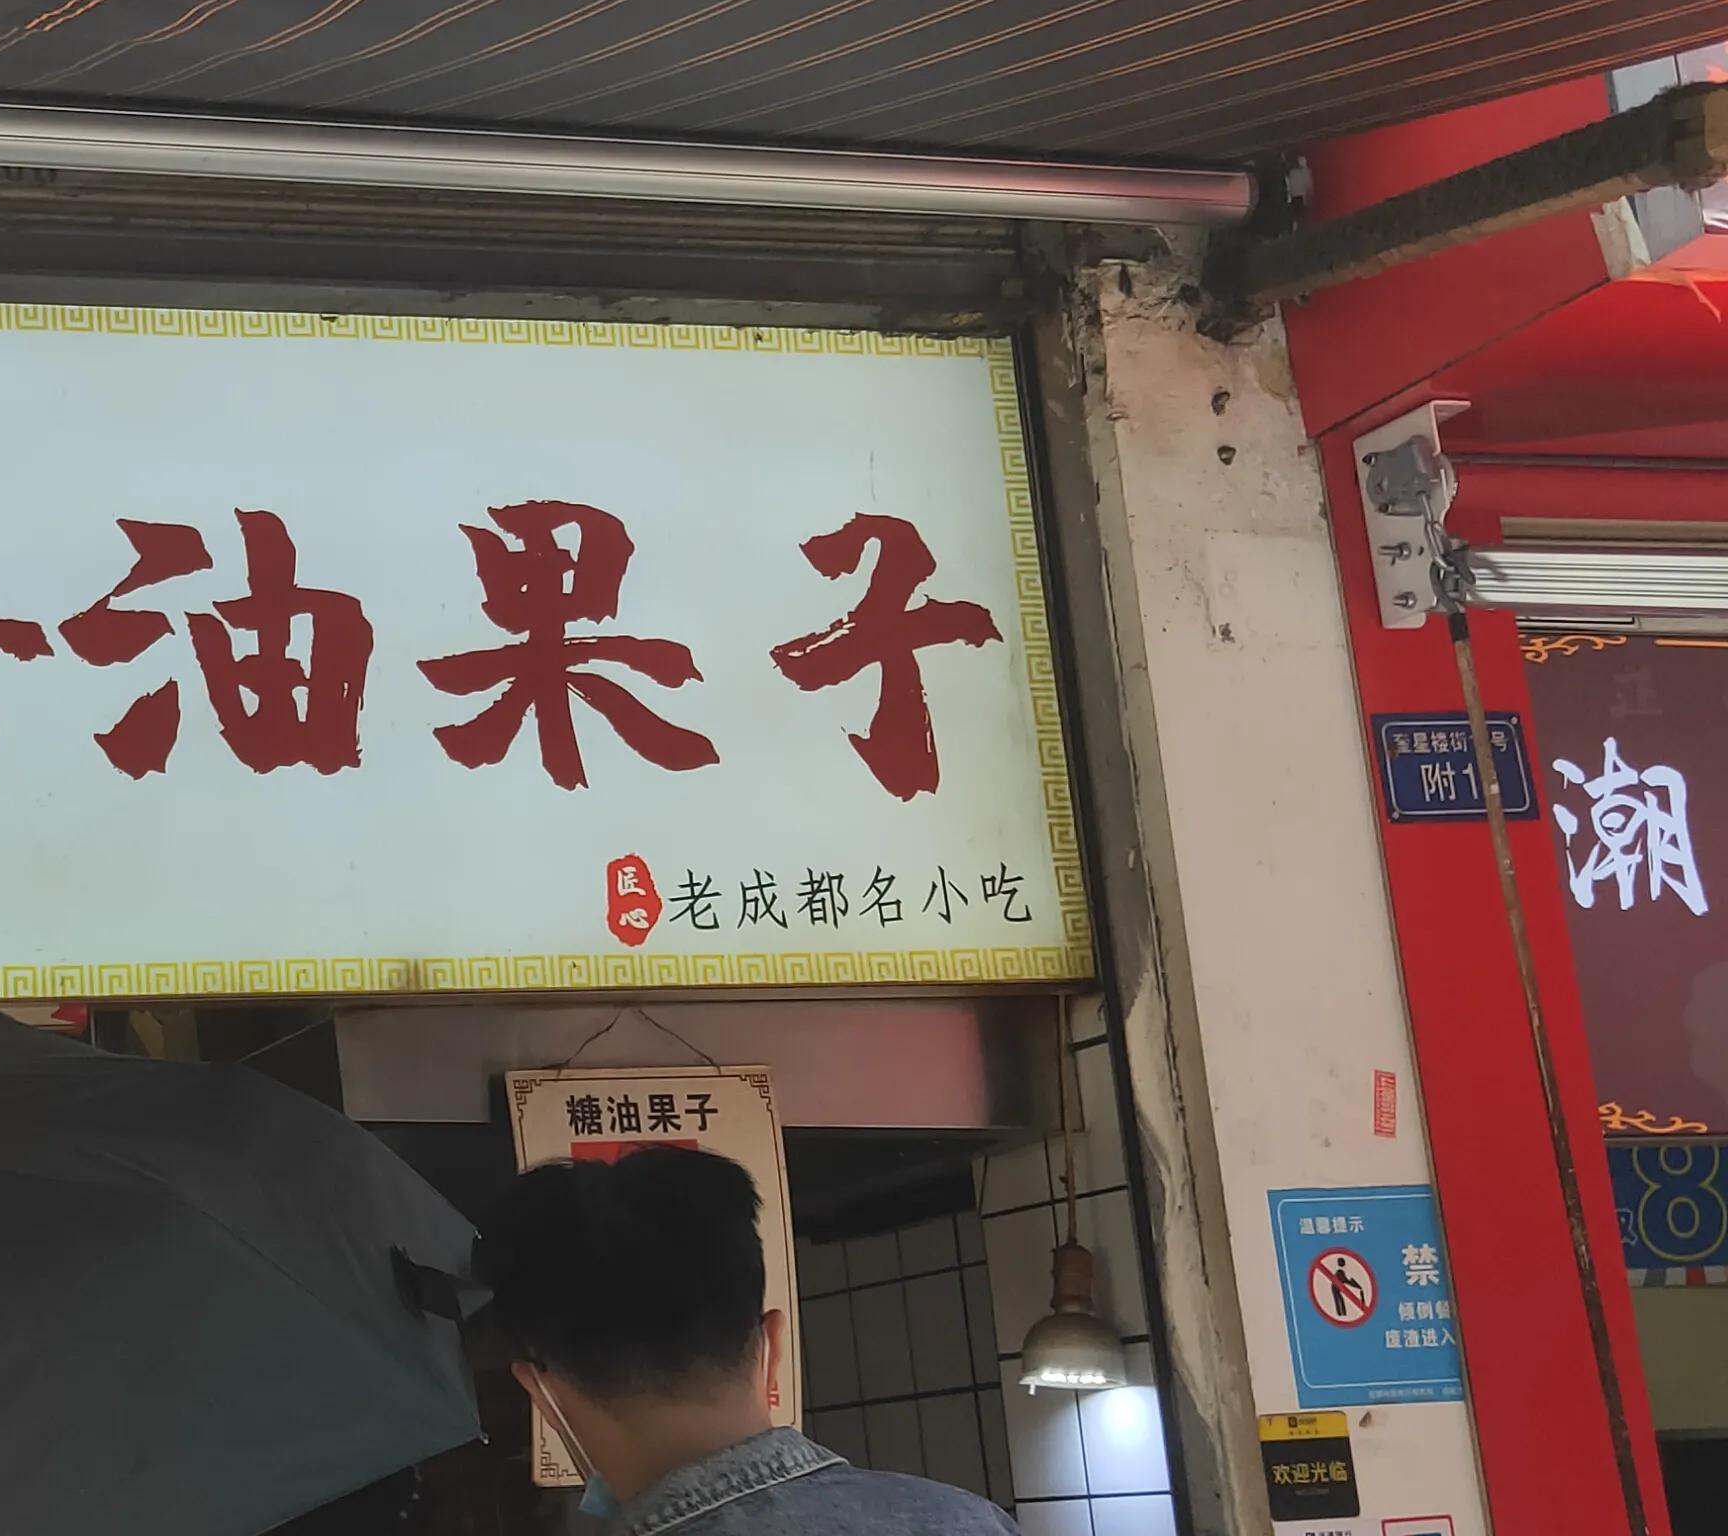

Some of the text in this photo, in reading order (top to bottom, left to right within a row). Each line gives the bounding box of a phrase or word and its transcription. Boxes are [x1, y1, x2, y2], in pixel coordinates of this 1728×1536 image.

[1552, 737, 1709, 916] 潮
[616, 865, 650, 930] 匠心
[667, 861, 1032, 930] 老成都名小吃
[566, 1093, 719, 1135] 糖油果子
[1298, 1216, 1365, 1235] 温馨提示
[1401, 1243, 1440, 1286] 禁
[1272, 1461, 1349, 1485] 欢迎光临
